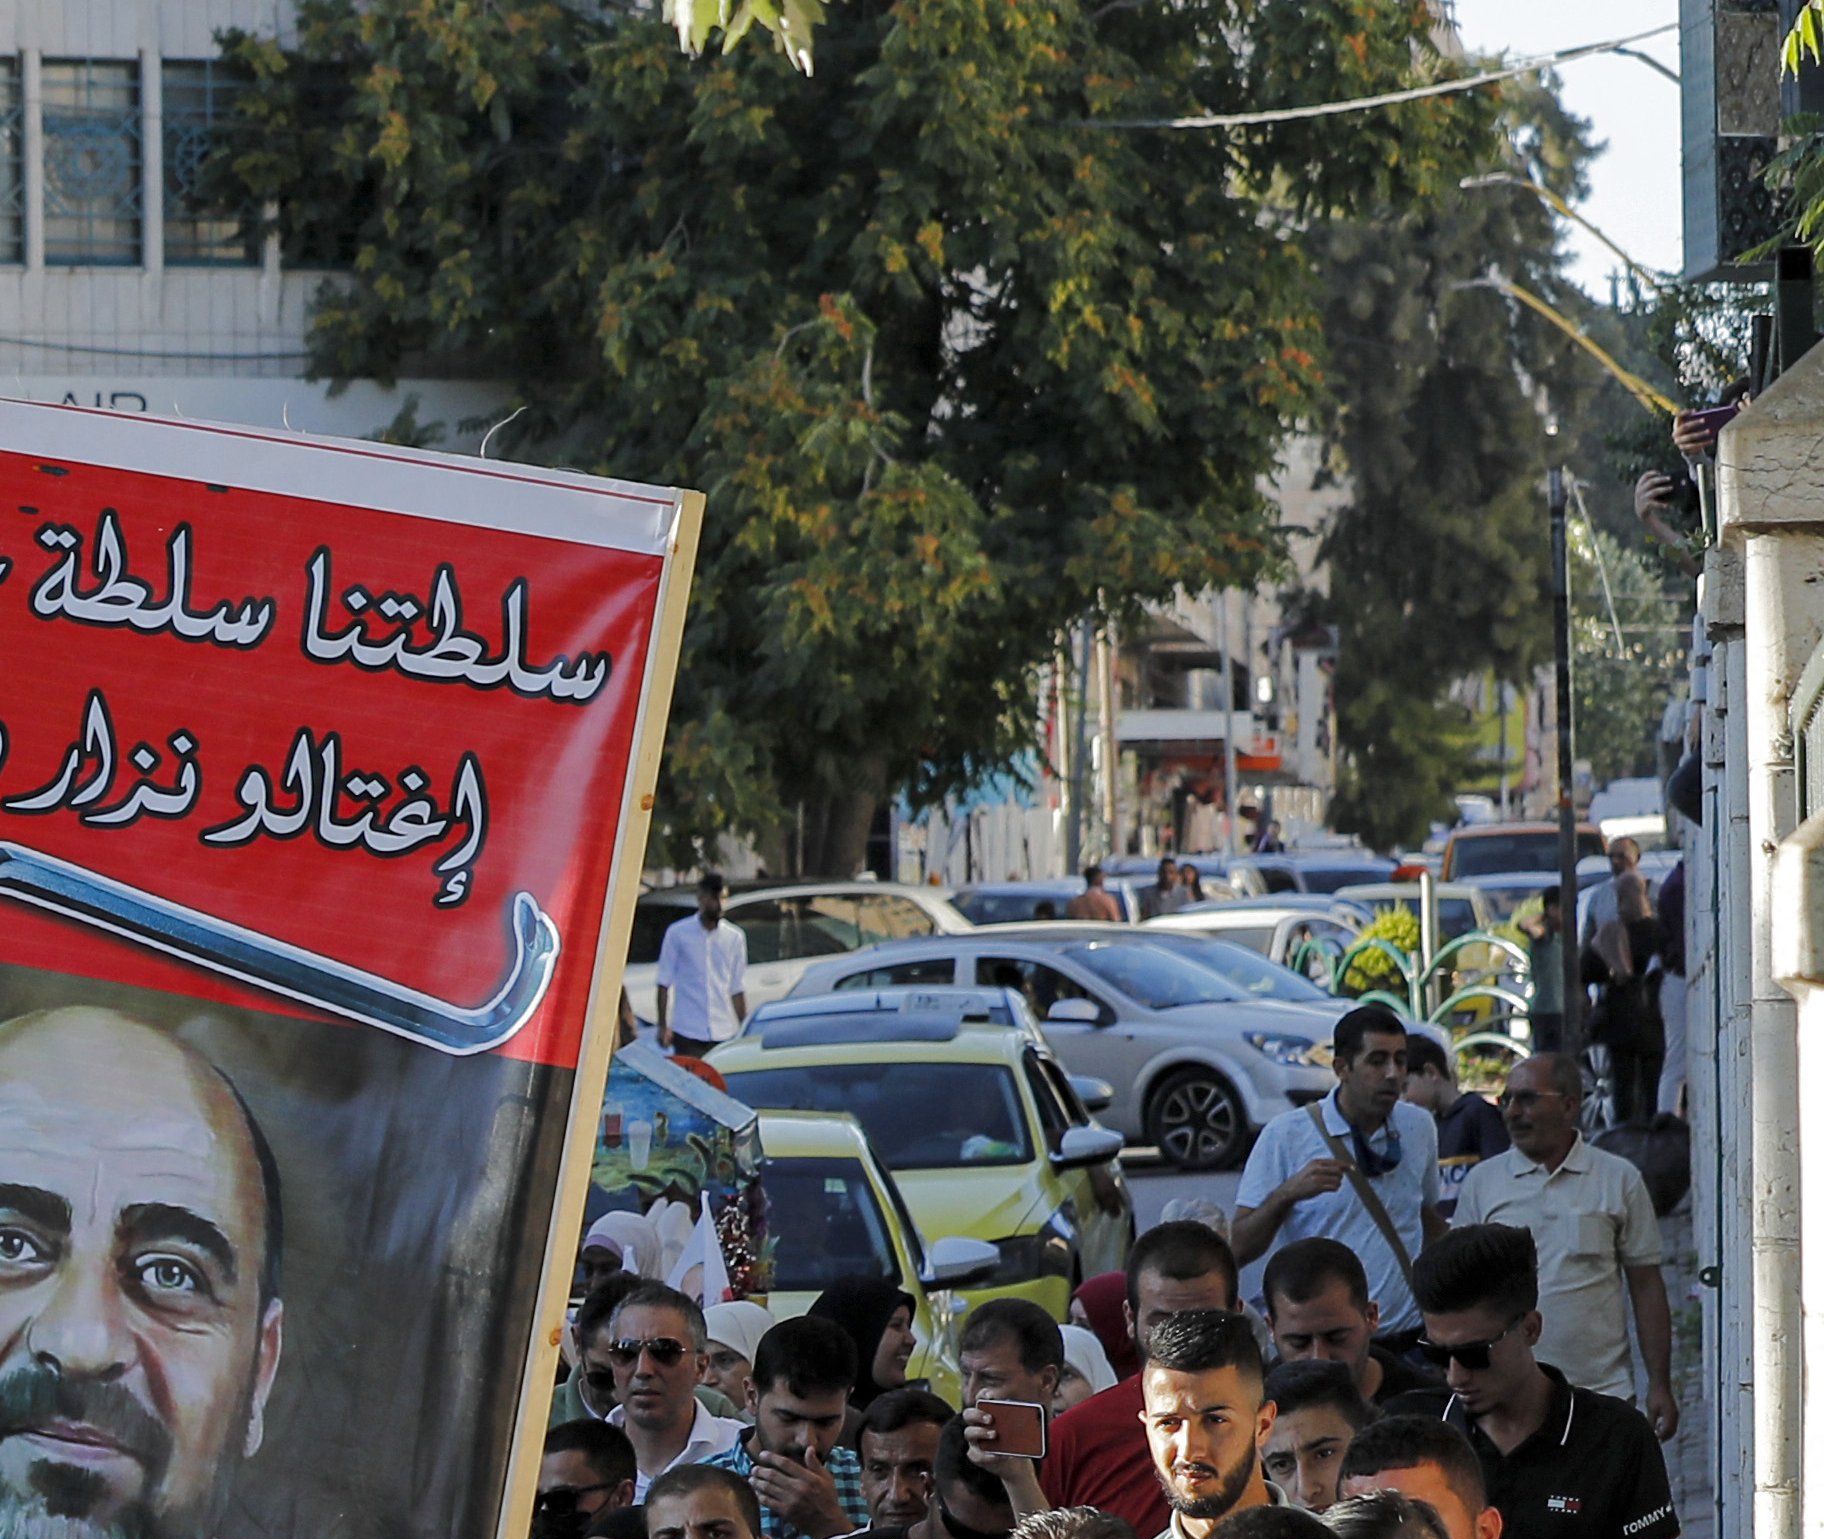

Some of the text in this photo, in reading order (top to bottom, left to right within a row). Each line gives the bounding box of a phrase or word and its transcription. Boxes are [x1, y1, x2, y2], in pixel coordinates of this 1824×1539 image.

[34, 513, 275, 650] سلطة
[305, 546, 611, 702] سلطتنا
[7, 691, 198, 825] نزار
[202, 728, 486, 906] إغتالو
[1622, 1505, 1666, 1537] TOMMY
